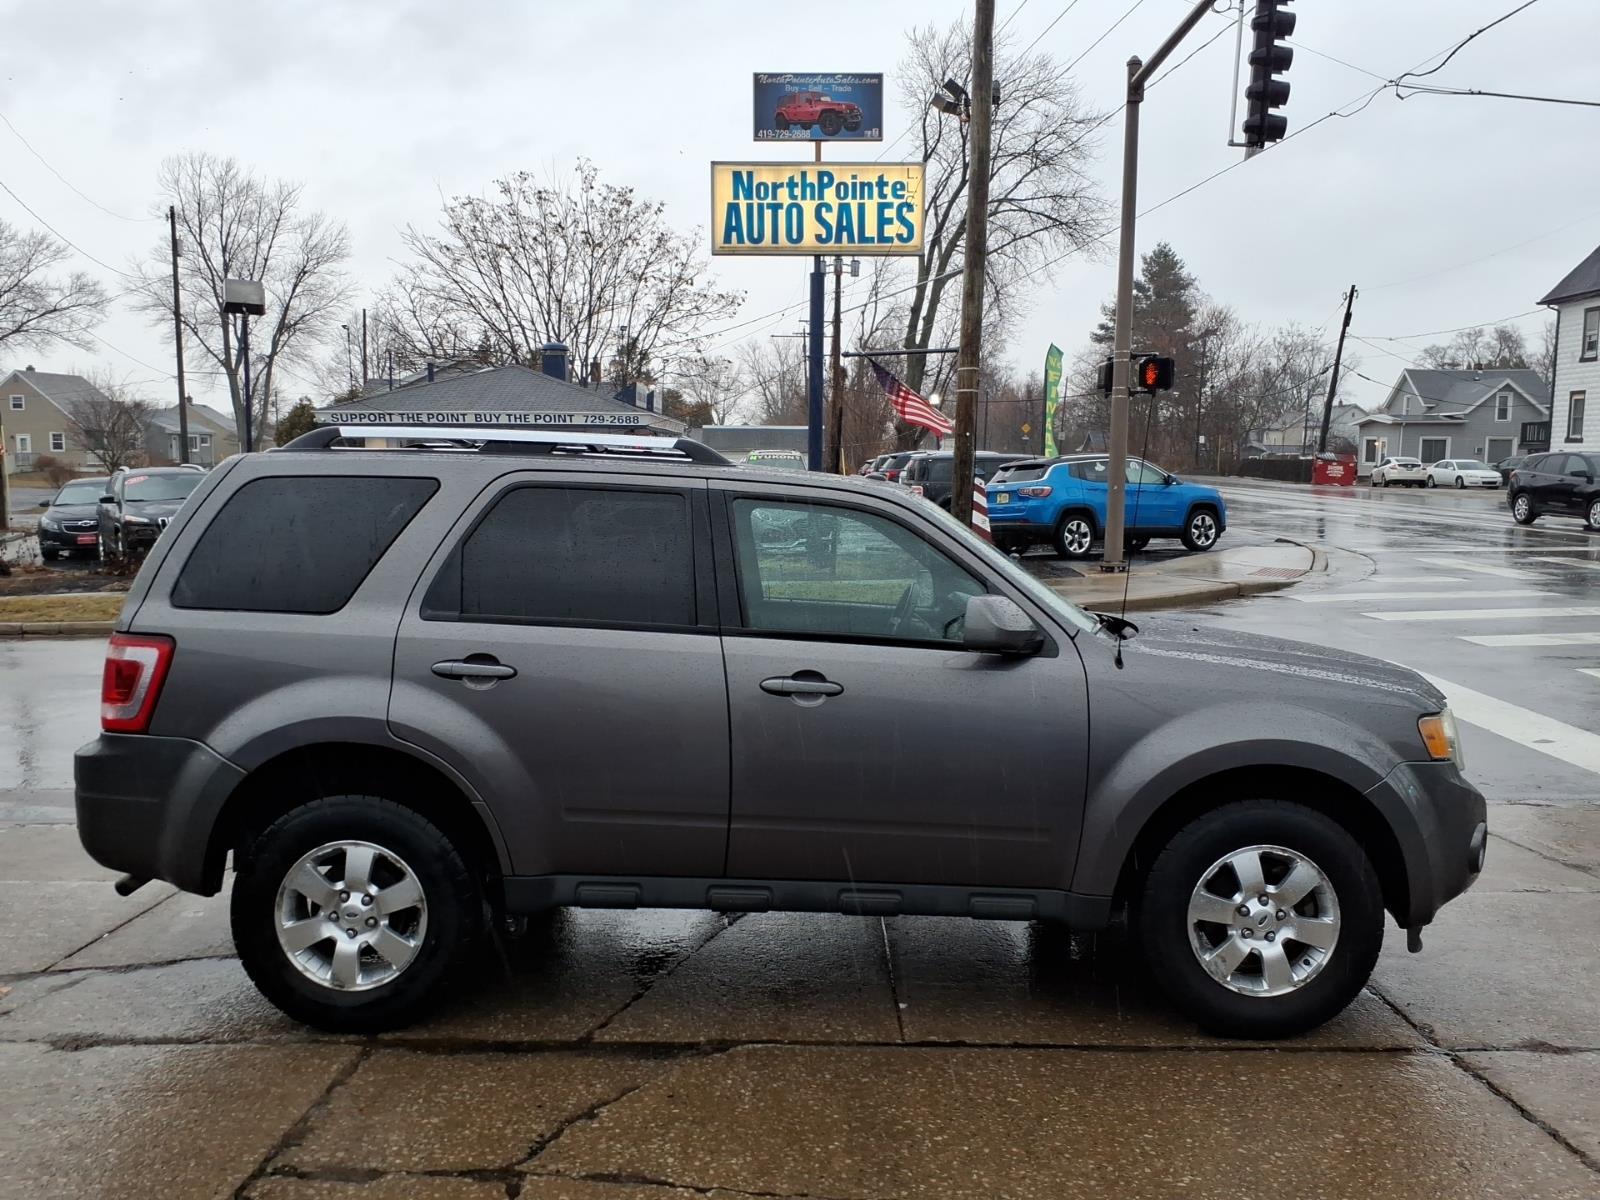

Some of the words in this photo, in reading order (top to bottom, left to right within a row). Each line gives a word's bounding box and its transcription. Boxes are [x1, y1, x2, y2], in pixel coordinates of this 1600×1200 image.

[758, 73, 879, 85] NorthPointeAutoSales.com
[785, 85, 798, 93] Buy
[758, 129, 811, 138] 419-729-2688
[732, 170, 906, 201] NorthPointe
[723, 202, 804, 245] AUTO
[814, 202, 915, 245] SALES
[331, 413, 395, 423] SUPPORT
[399, 413, 424, 423] THE
[427, 413, 468, 423] POINT
[474, 413, 502, 423] BUY
[505, 413, 530, 423] THE
[534, 414, 575, 424] POINT
[583, 414, 640, 424] 729-2688
